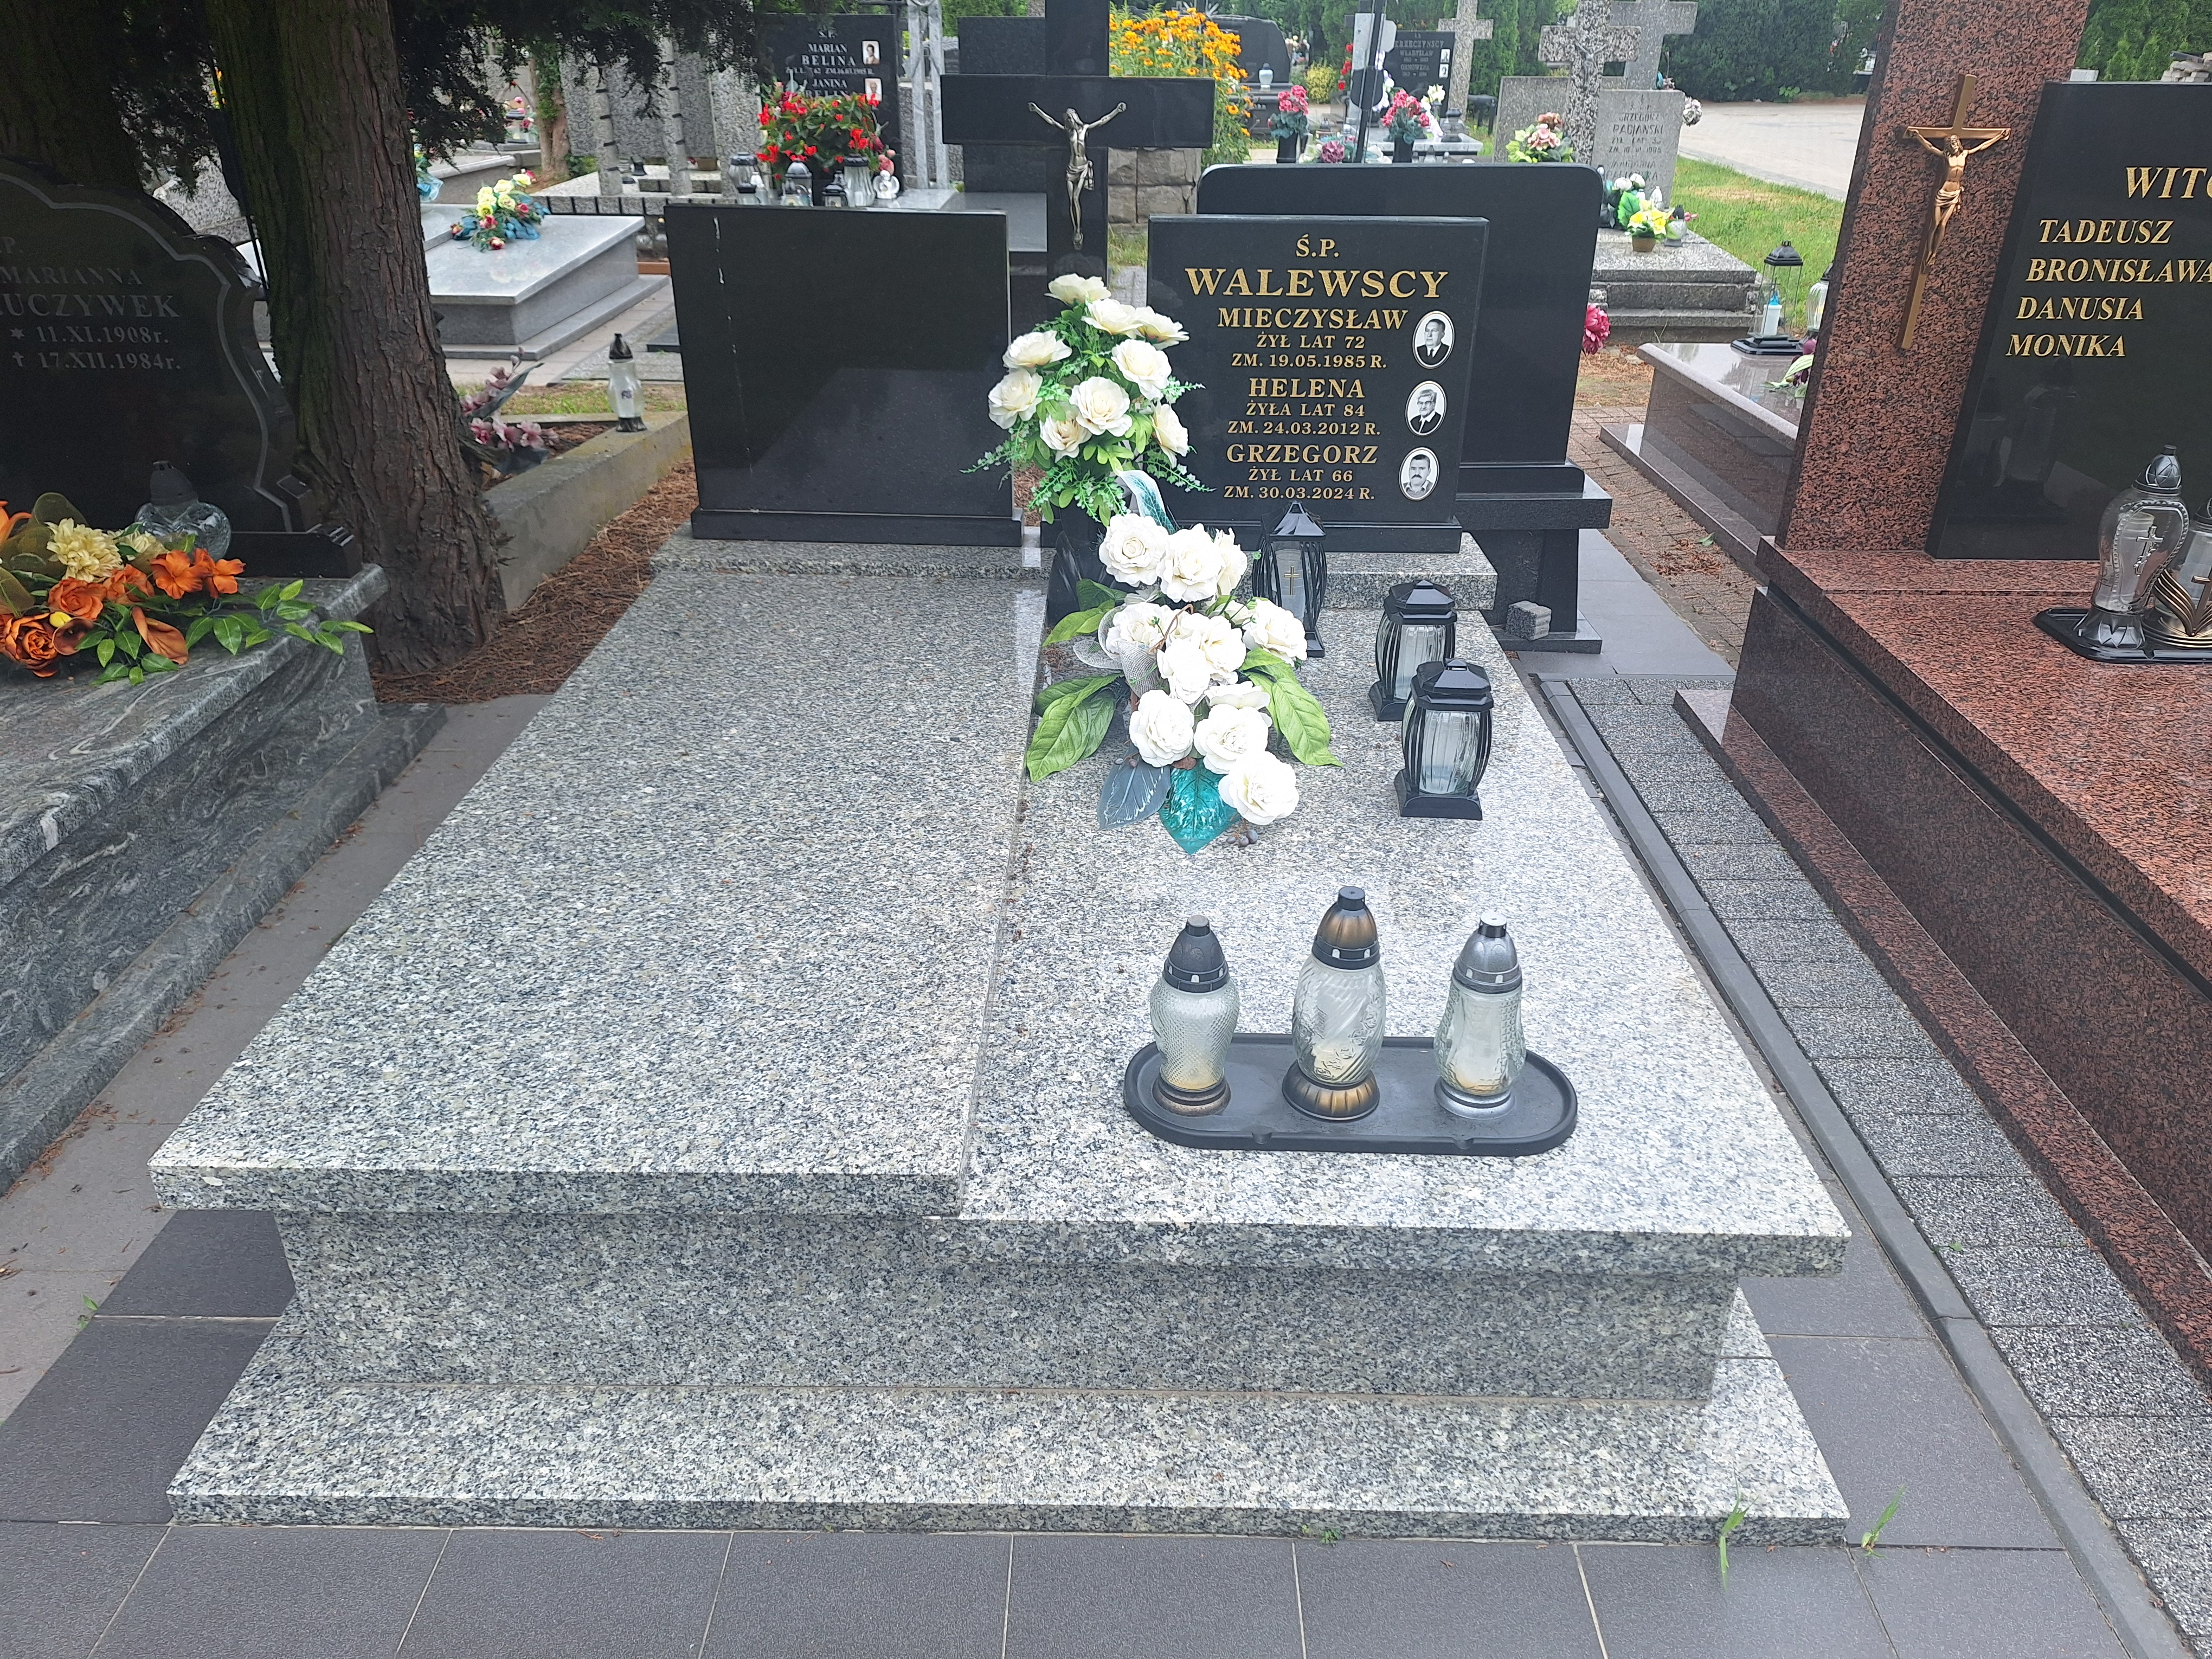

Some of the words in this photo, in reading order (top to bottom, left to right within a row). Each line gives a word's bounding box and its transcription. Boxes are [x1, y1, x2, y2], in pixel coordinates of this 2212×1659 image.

[807, 43, 848, 53] MARIAN
[801, 55, 856, 67] BELINA
[812, 78, 848, 88] JANINA
[805, 89, 848, 98] BELIN
[2039, 219, 2175, 244] TADEUSZ
[1295, 234, 1340, 258] Ś.P.
[2025, 258, 2212, 283] BRONISŁAWA
[1184, 267, 1449, 298] WALEWSCY
[0, 293, 181, 318] UCZYWEK
[2015, 296, 2144, 320] DANUSIA
[1217, 306, 1409, 330] MIECZYSŁAW
[1256, 331, 1291, 349] ŻYŁ
[1299, 334, 1335, 349] LAT
[1344, 335, 1366, 349] 72
[2005, 333, 2126, 357] MONIKA
[1231, 352, 1264, 367] ZM.
[1269, 353, 1365, 369] 19.05.1985
[1370, 355, 1387, 369] R.
[1248, 377, 1366, 398] HELENA
[1245, 400, 1292, 416] ŻYŁA
[1300, 403, 1336, 417] LAT
[1343, 404, 1366, 417] 84
[1227, 420, 1259, 434] ZM.
[1262, 421, 1359, 435] 24.03.2012
[1364, 422, 1381, 435] R.
[1226, 443, 1379, 464] GRZEGORZ
[1248, 465, 1282, 481] ŻYŁ
[1289, 468, 1324, 482] LAT
[1332, 469, 1353, 483] 66
[1223, 485, 1255, 498] ZM.
[1258, 486, 1354, 499] 30.03.2024
[1358, 487, 1375, 499] R.
